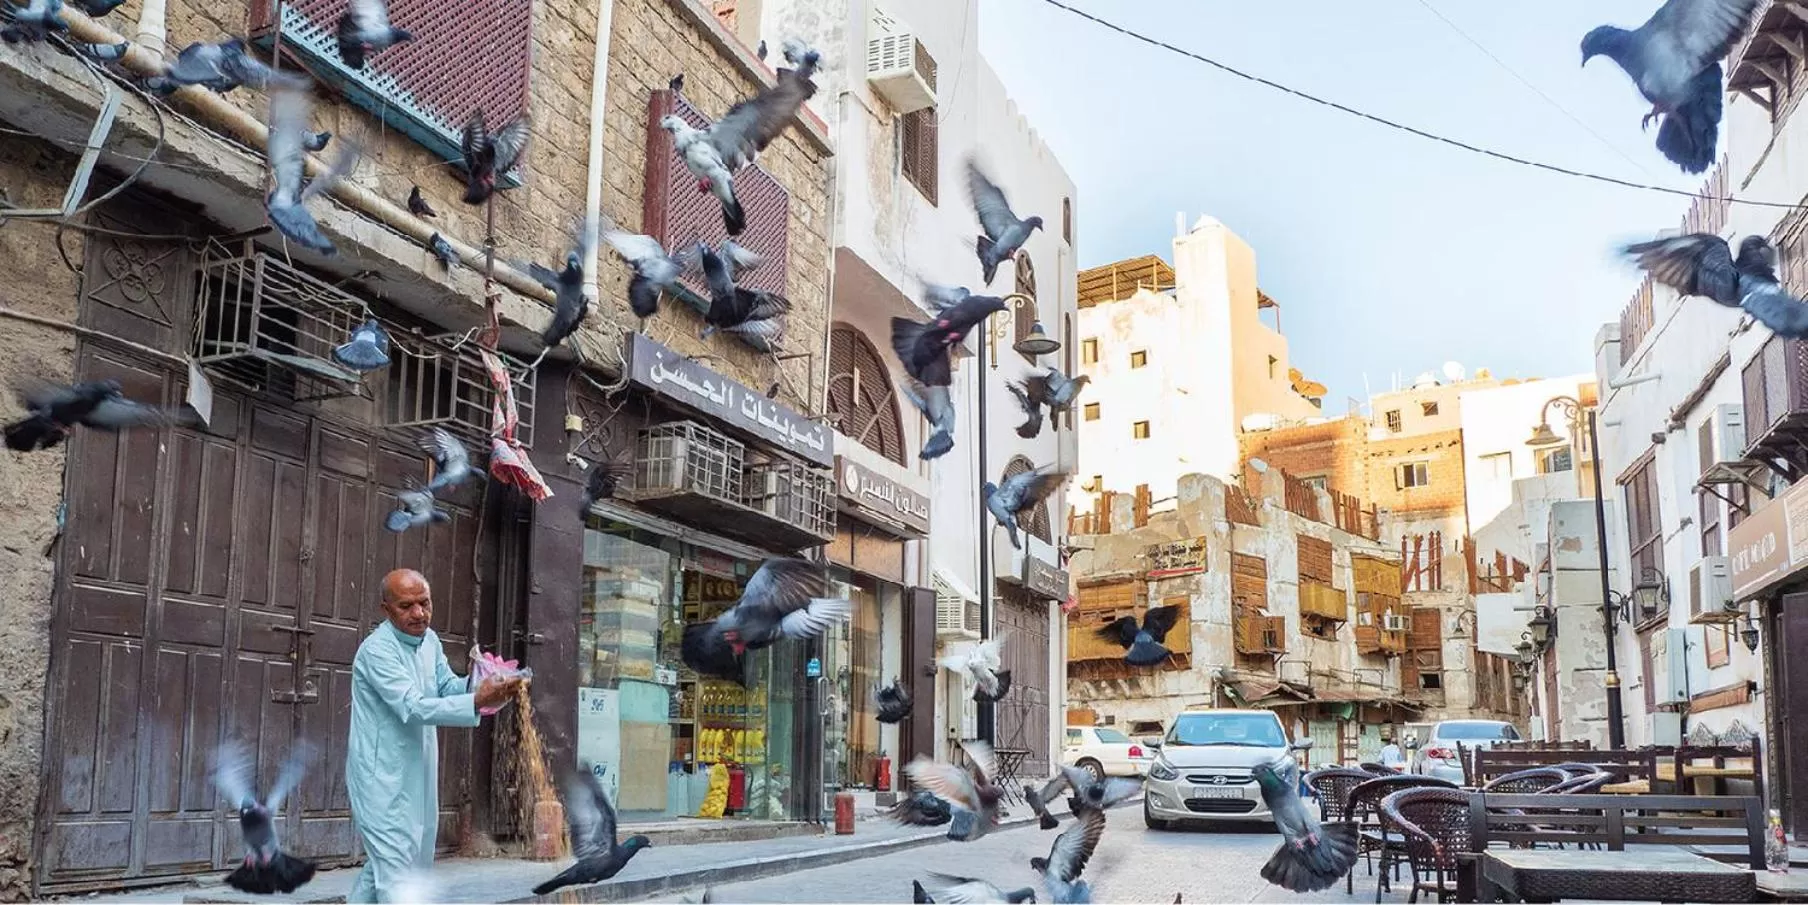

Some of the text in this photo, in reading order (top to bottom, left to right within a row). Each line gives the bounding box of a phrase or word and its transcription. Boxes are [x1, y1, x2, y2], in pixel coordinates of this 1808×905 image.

[650, 351, 825, 451] تموينات الحسن
[895, 488, 928, 519] صالون
